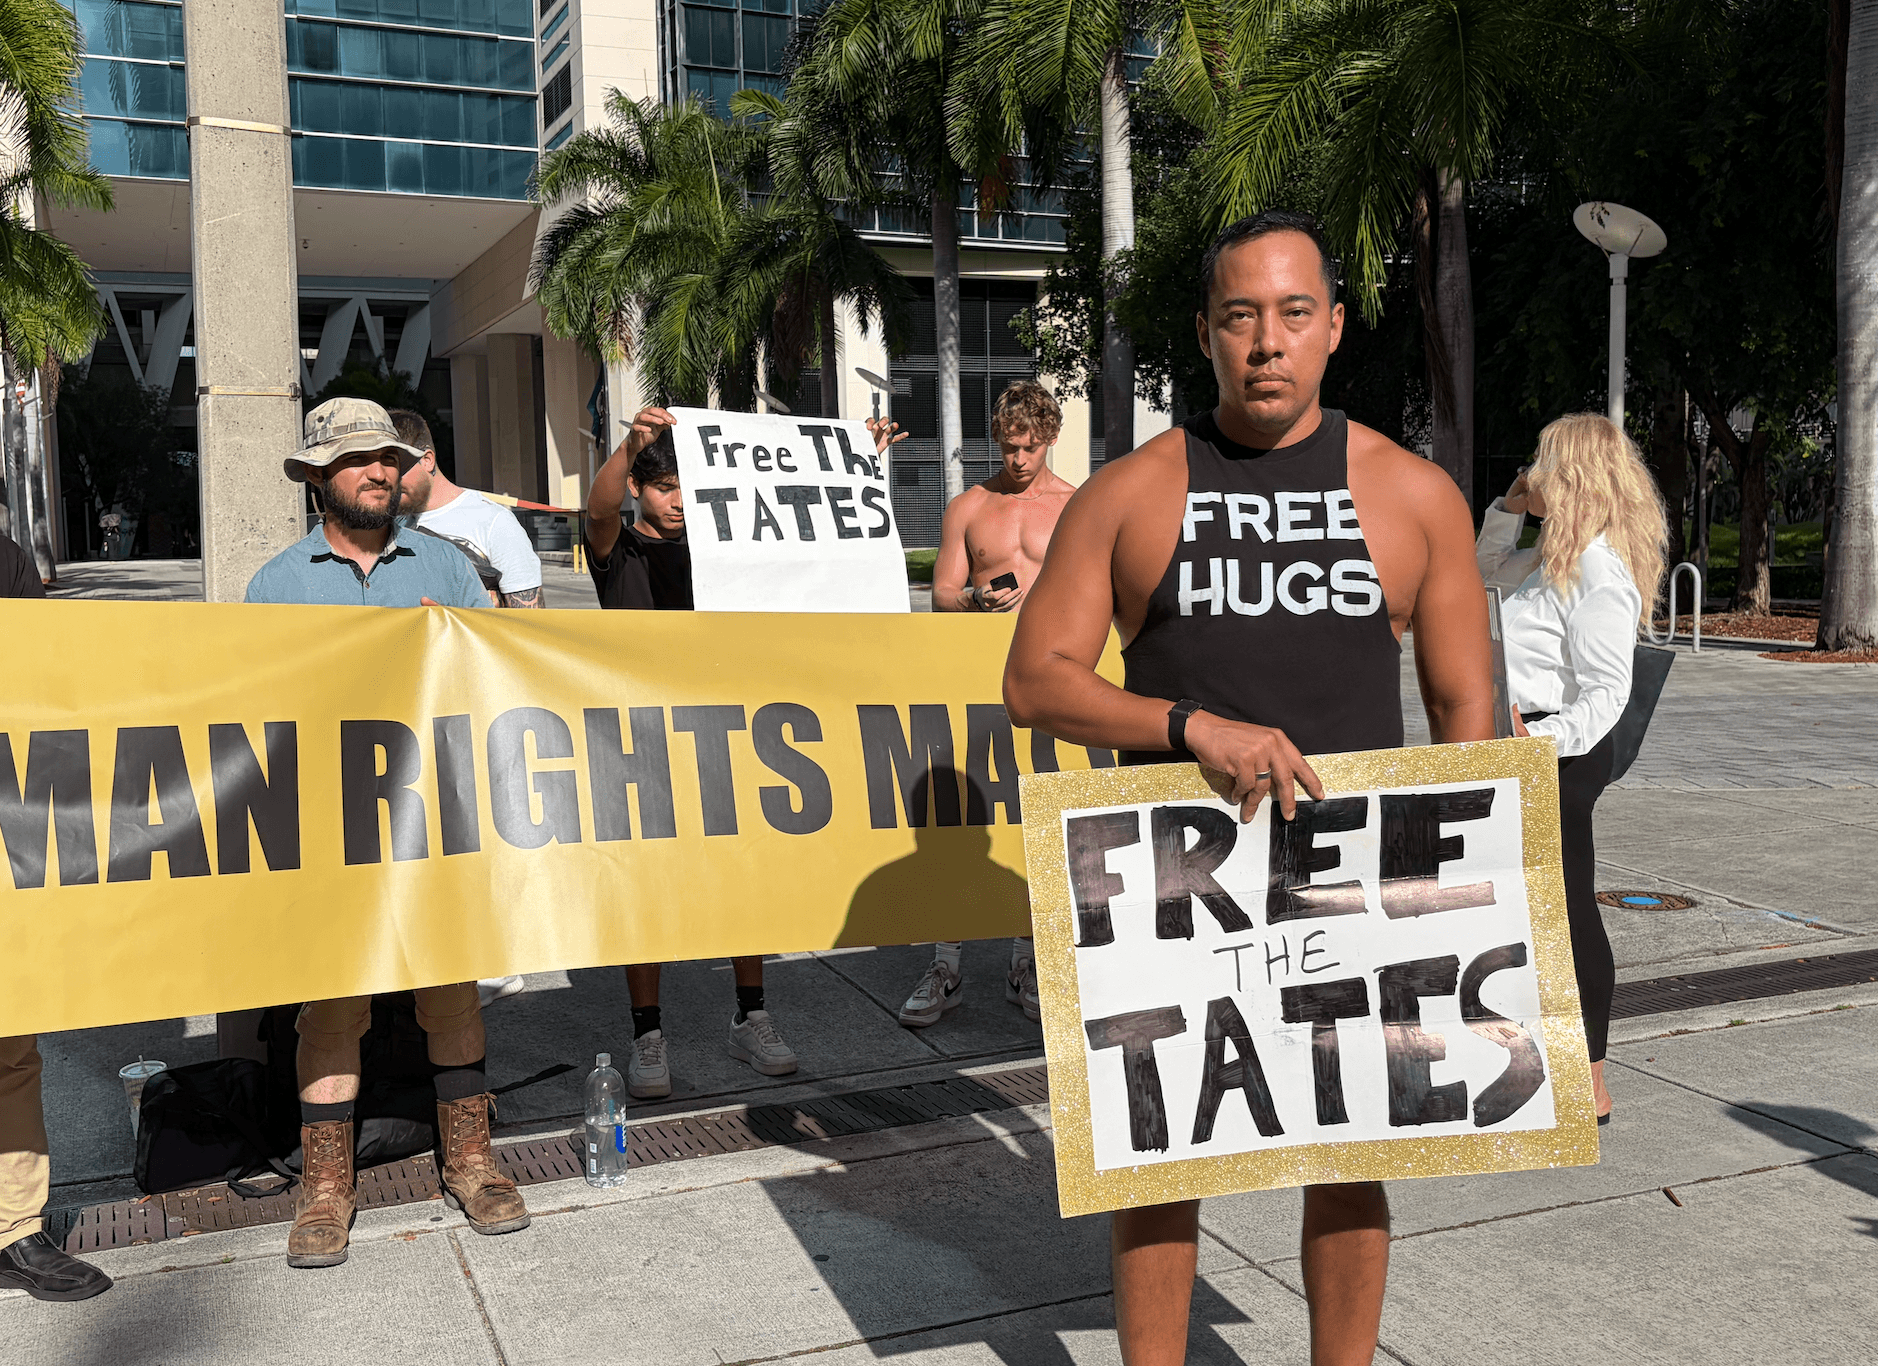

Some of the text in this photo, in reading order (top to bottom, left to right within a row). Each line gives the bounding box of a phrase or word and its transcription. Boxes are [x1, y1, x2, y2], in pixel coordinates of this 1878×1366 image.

[697, 425, 798, 473] Free
[694, 485, 891, 541] TATES
[1182, 489, 1364, 543] FREE
[1178, 557, 1383, 616] HUGS
[340, 702, 833, 866] RIGHTS
[856, 703, 1117, 829] MA
[1066, 787, 1496, 947] FREE
[1212, 930, 1340, 992] THE
[1084, 942, 1546, 1153] TATES
